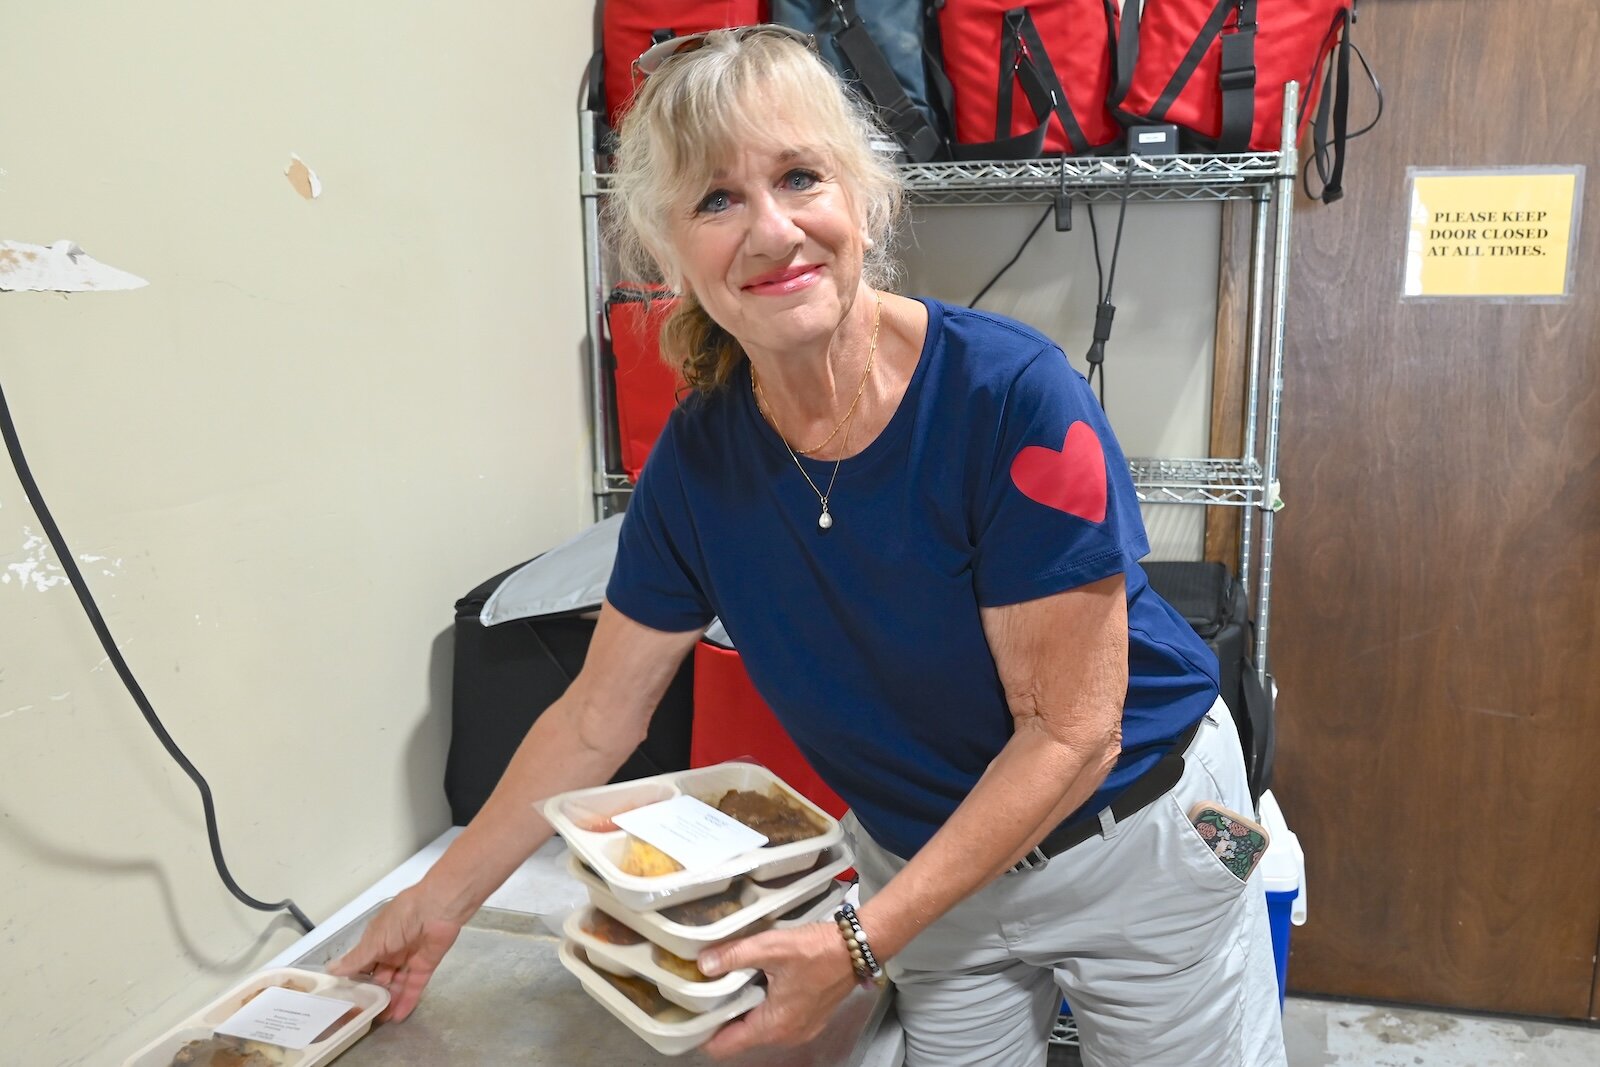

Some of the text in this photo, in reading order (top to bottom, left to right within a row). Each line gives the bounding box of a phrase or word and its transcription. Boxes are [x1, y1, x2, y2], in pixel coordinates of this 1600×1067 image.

[1435, 211, 1547, 223] PLEASE KEEP
[1430, 228, 1548, 240] DOOR CLOSED
[1427, 245, 1546, 256] AT ALL TIMES.
